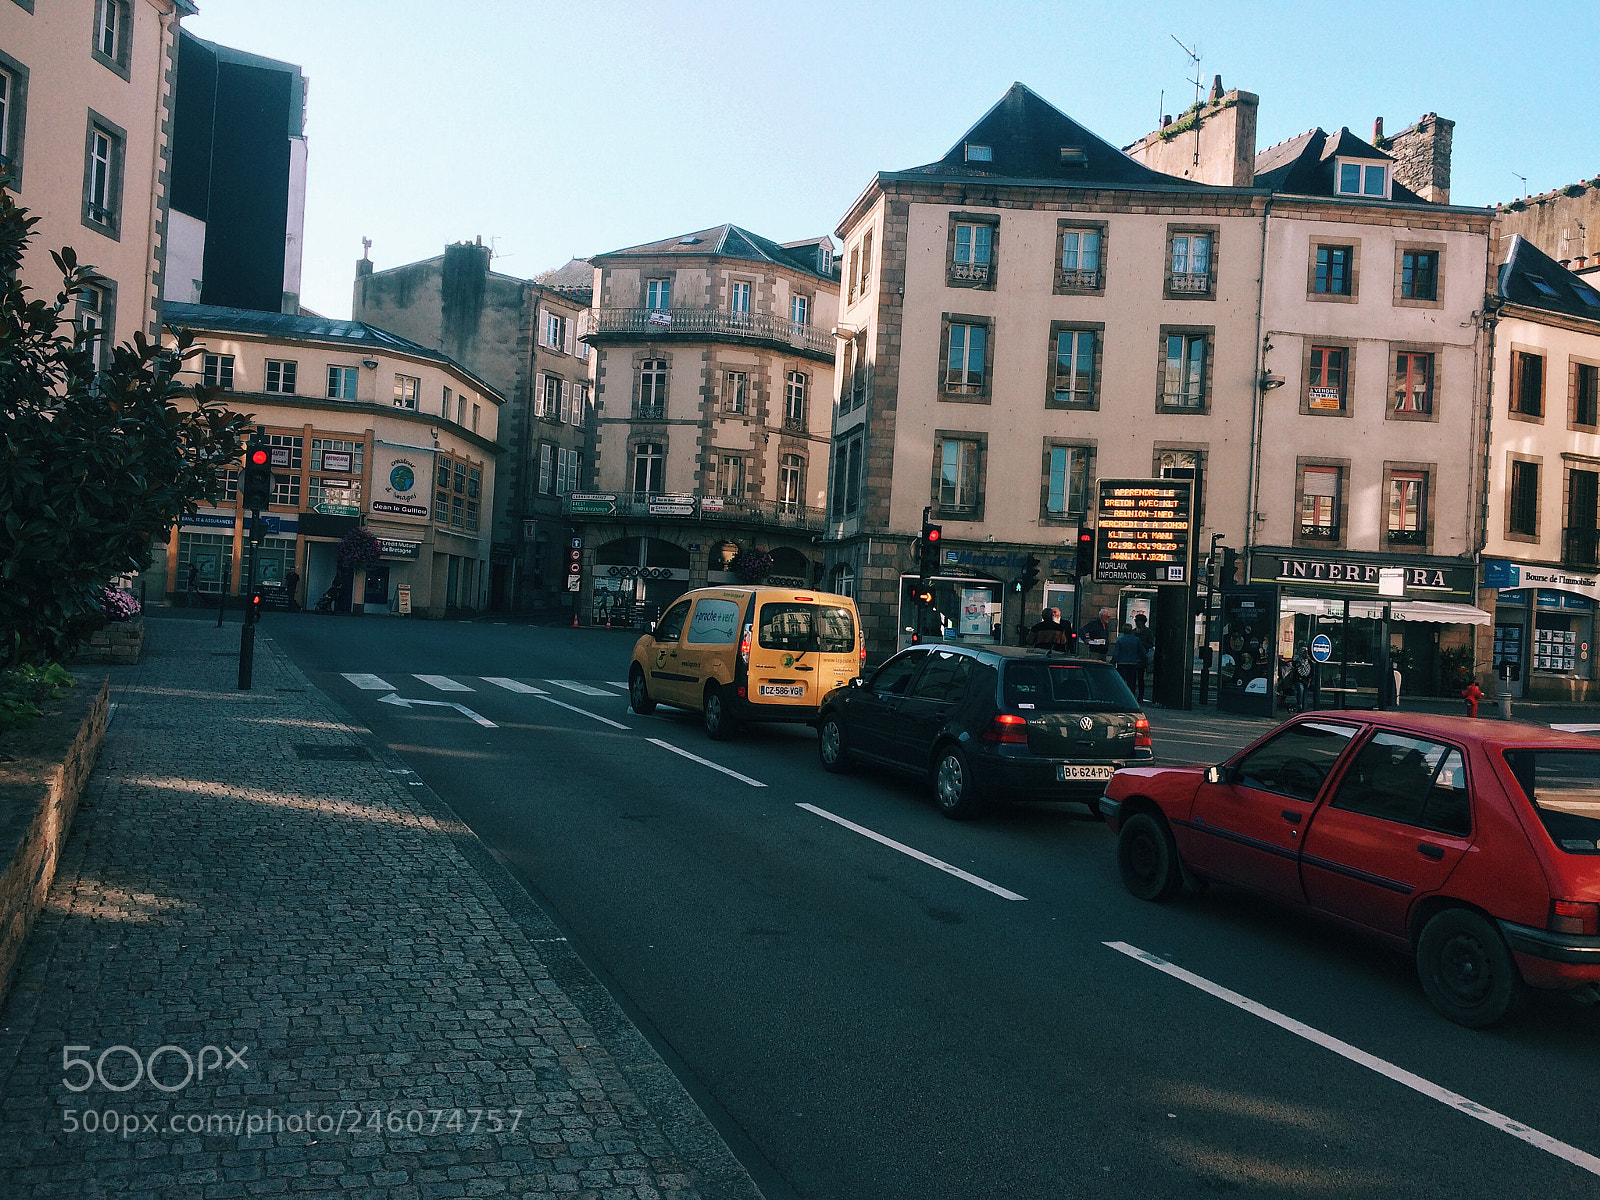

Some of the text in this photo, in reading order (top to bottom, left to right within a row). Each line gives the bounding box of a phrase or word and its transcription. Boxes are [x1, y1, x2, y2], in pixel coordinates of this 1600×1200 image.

[1114, 489, 1175, 497] APPRENDRE LE
[1104, 499, 1135, 507] BRETON
[374, 503, 392, 511] Jean
[401, 506, 427, 515] Guillou
[1098, 521, 1138, 529] MERCREDI
[1151, 532, 1173, 540] MANU
[1099, 562, 1127, 570] MORLAIX
[1099, 572, 1147, 580] INFORMATIONS
[1282, 561, 1446, 586] INTERFRA
[1525, 572, 1597, 587] Bourse de l'Immobilier
[1367, 610, 1406, 620] FLRS
